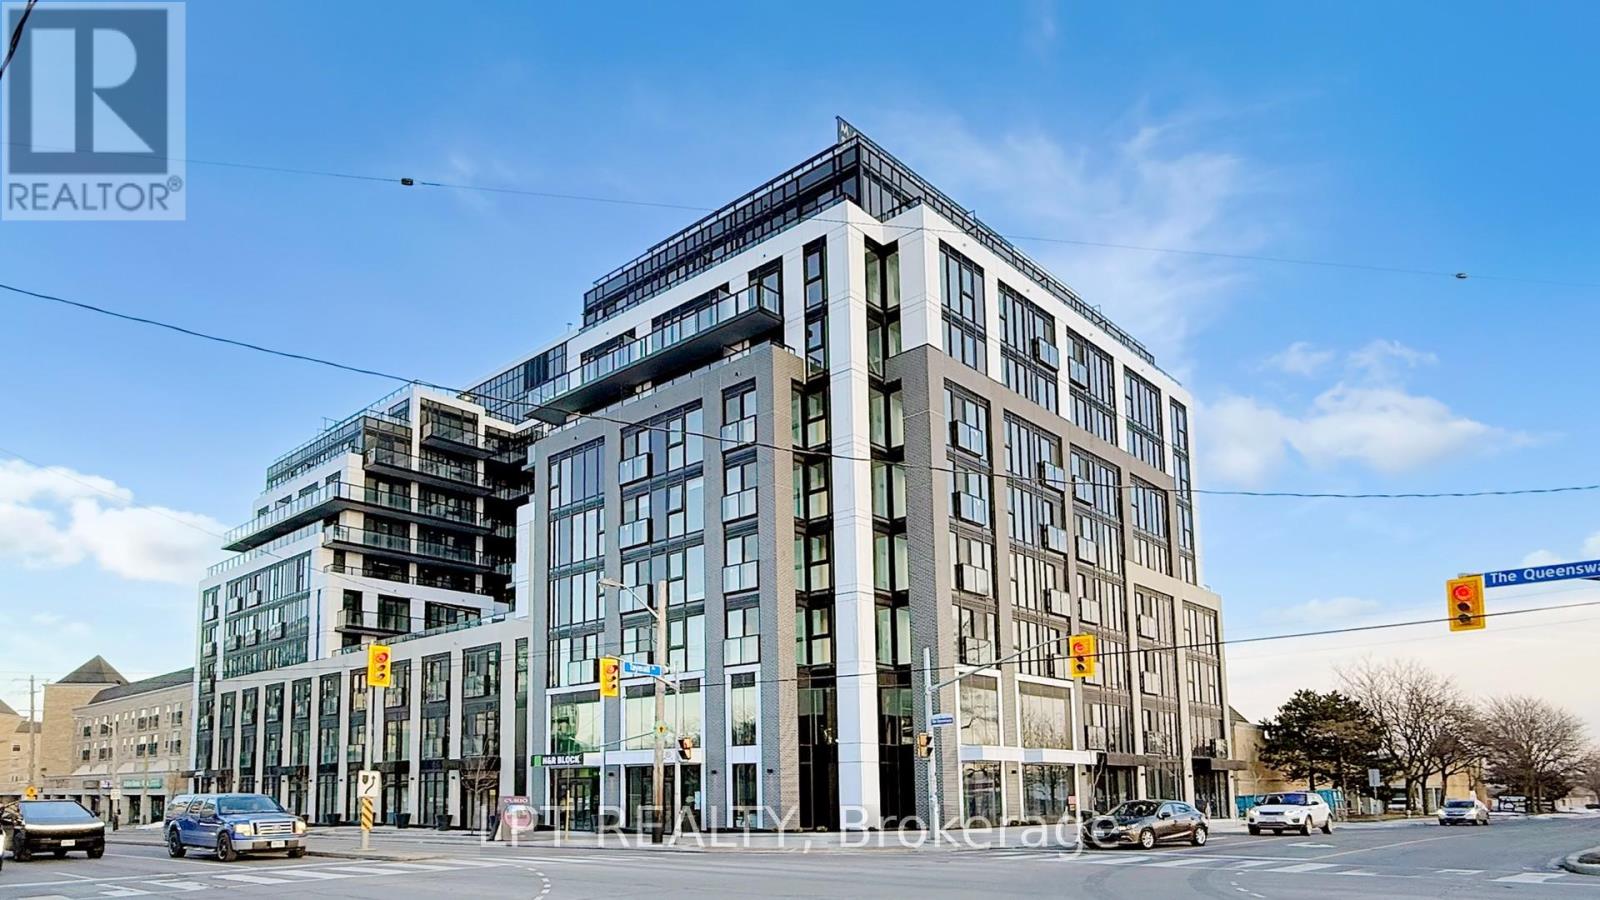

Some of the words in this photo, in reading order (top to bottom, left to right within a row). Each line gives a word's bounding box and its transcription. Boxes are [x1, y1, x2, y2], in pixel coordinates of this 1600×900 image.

[1490, 572, 1517, 583] The
[1523, 563, 1600, 580] Queensw
[543, 756, 556, 765] H&R
[557, 755, 580, 765] BLOCK
